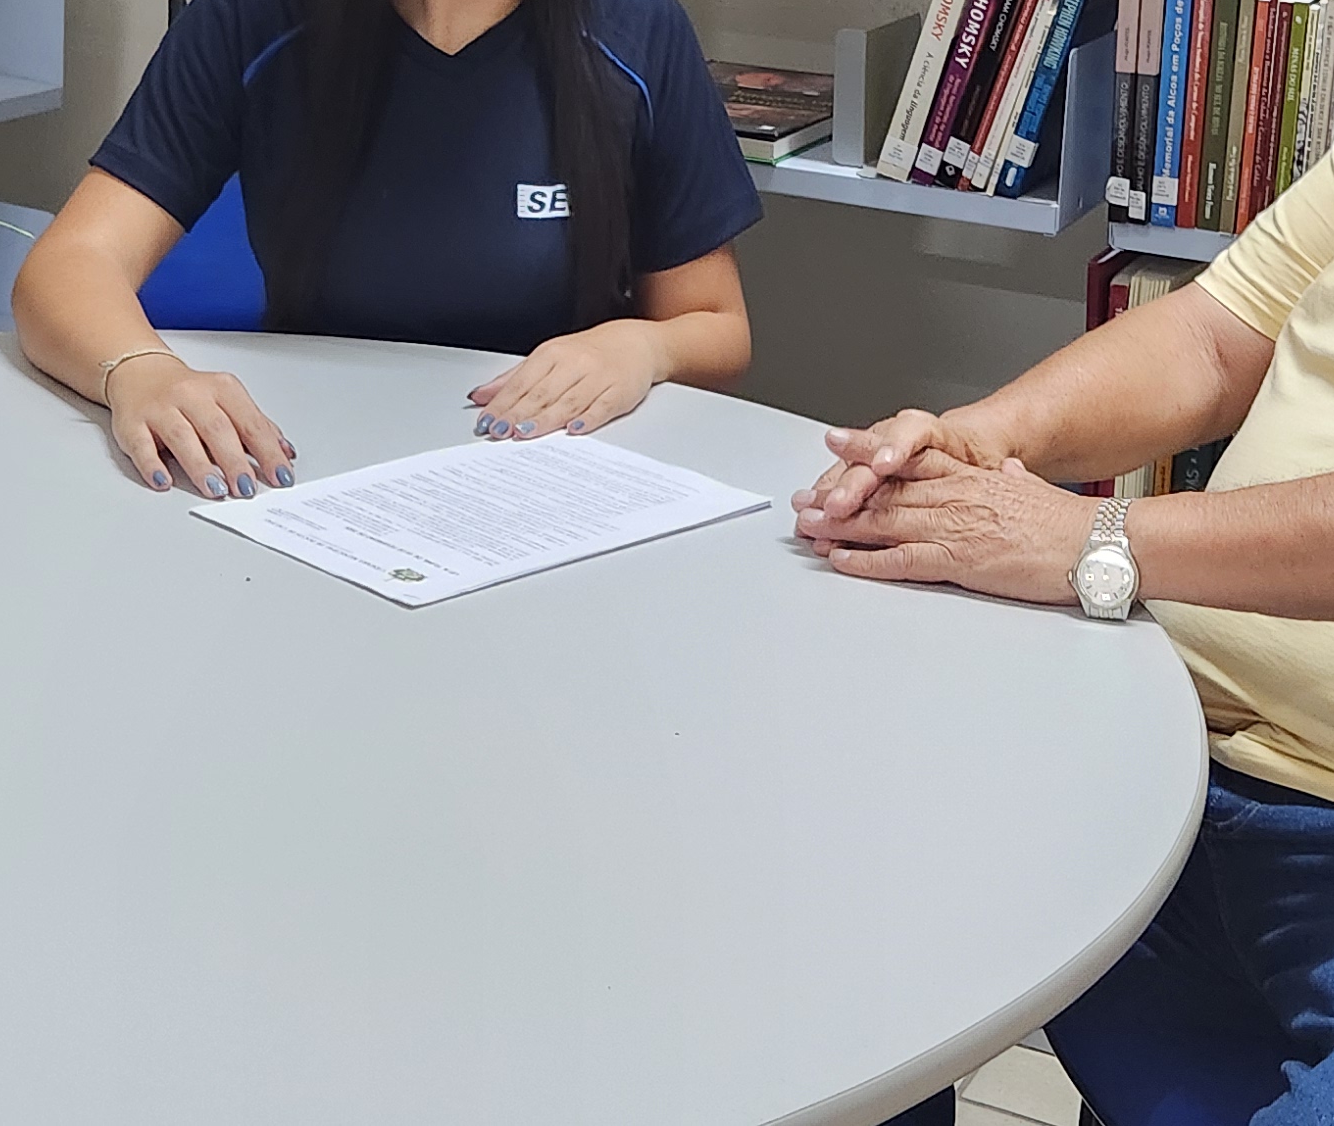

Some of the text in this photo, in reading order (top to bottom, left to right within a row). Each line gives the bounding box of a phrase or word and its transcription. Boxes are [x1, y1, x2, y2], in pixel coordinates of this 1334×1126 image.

[1174, 0, 1184, 14] de
[989, 13, 1010, 52] CHOMSKY
[1042, 26, 1071, 70] HAWKING
[1171, 16, 1184, 52] Poços
[1171, 54, 1179, 72] em
[1286, 46, 1300, 103] MINAS DO SUL
[898, 52, 933, 141] A ciência da linguagem
[1167, 75, 1179, 108] Alcoa
[1165, 110, 1175, 124] da
[1162, 126, 1174, 179] Memorial
